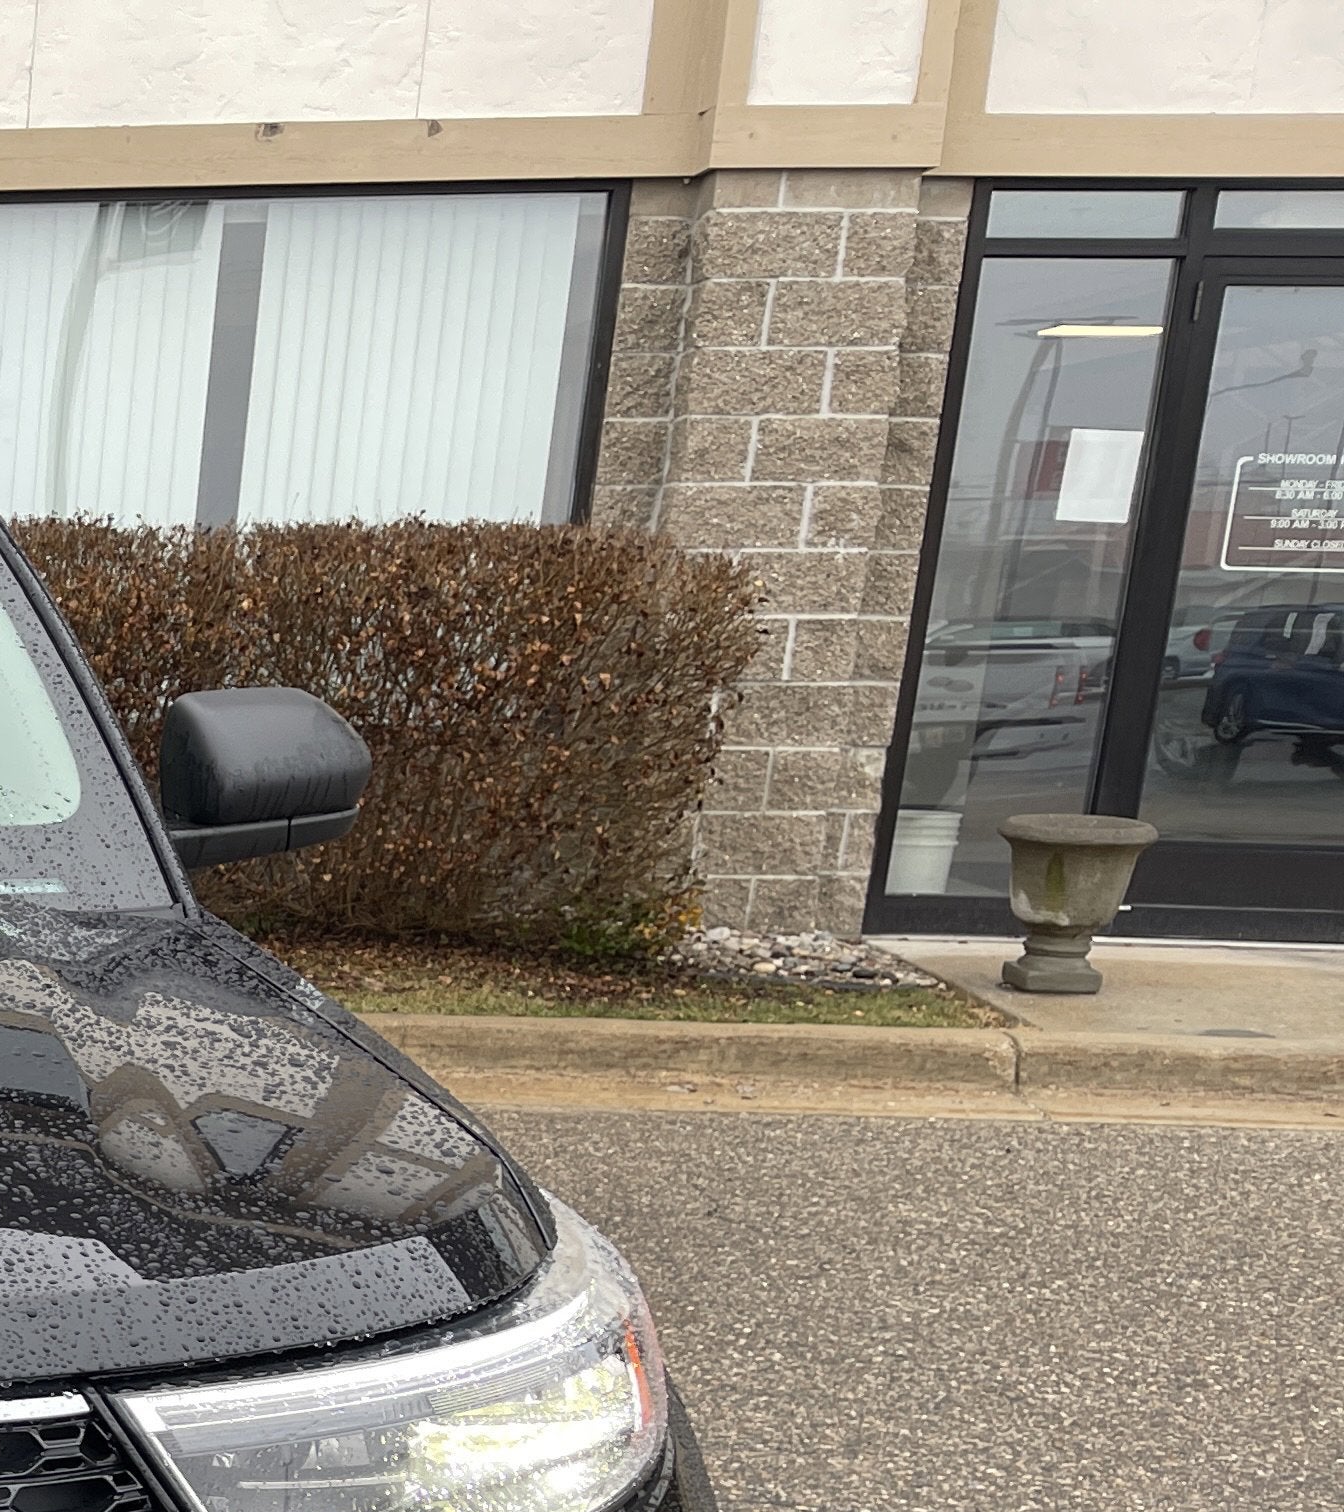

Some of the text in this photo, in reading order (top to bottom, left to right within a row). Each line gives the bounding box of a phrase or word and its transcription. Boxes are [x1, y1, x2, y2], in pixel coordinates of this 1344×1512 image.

[1257, 453, 1337, 465] SHOWROOM
[1280, 480, 1319, 490] MONDAY
[1297, 490, 1315, 500] AM
[1291, 508, 1339, 519] SATURDAY
[1292, 519, 1310, 528] AM
[1273, 539, 1310, 550] SUNDAY
